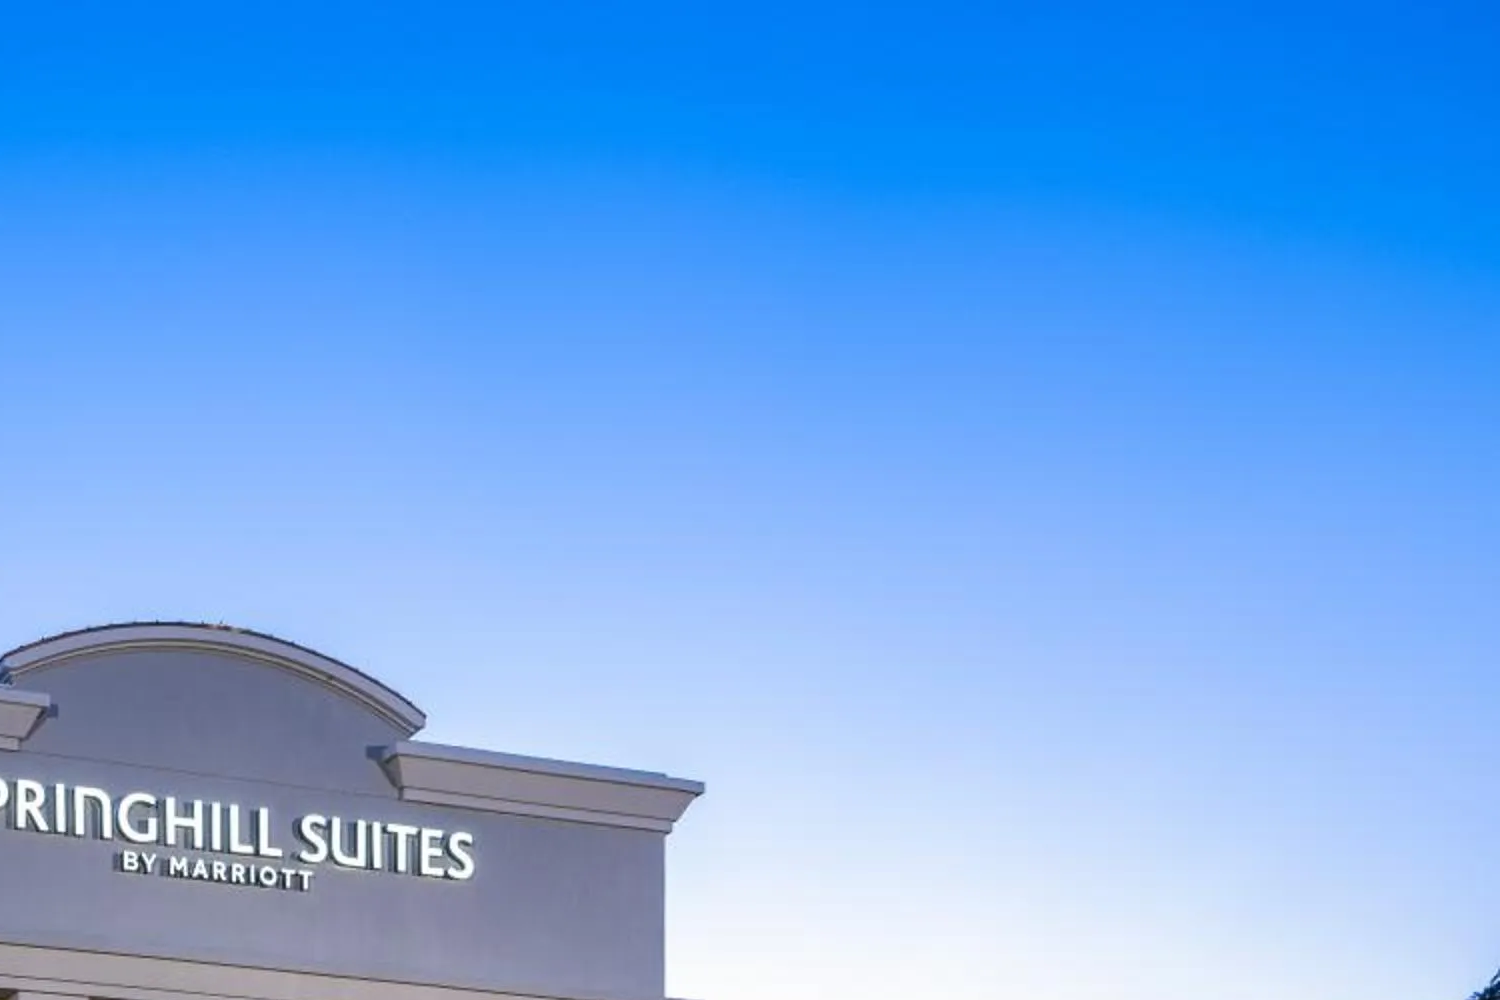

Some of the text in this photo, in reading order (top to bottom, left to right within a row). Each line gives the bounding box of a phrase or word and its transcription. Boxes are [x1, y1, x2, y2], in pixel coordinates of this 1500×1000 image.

[123, 849, 314, 890] BY MARRIOTT
[299, 813, 475, 879] SUITES
